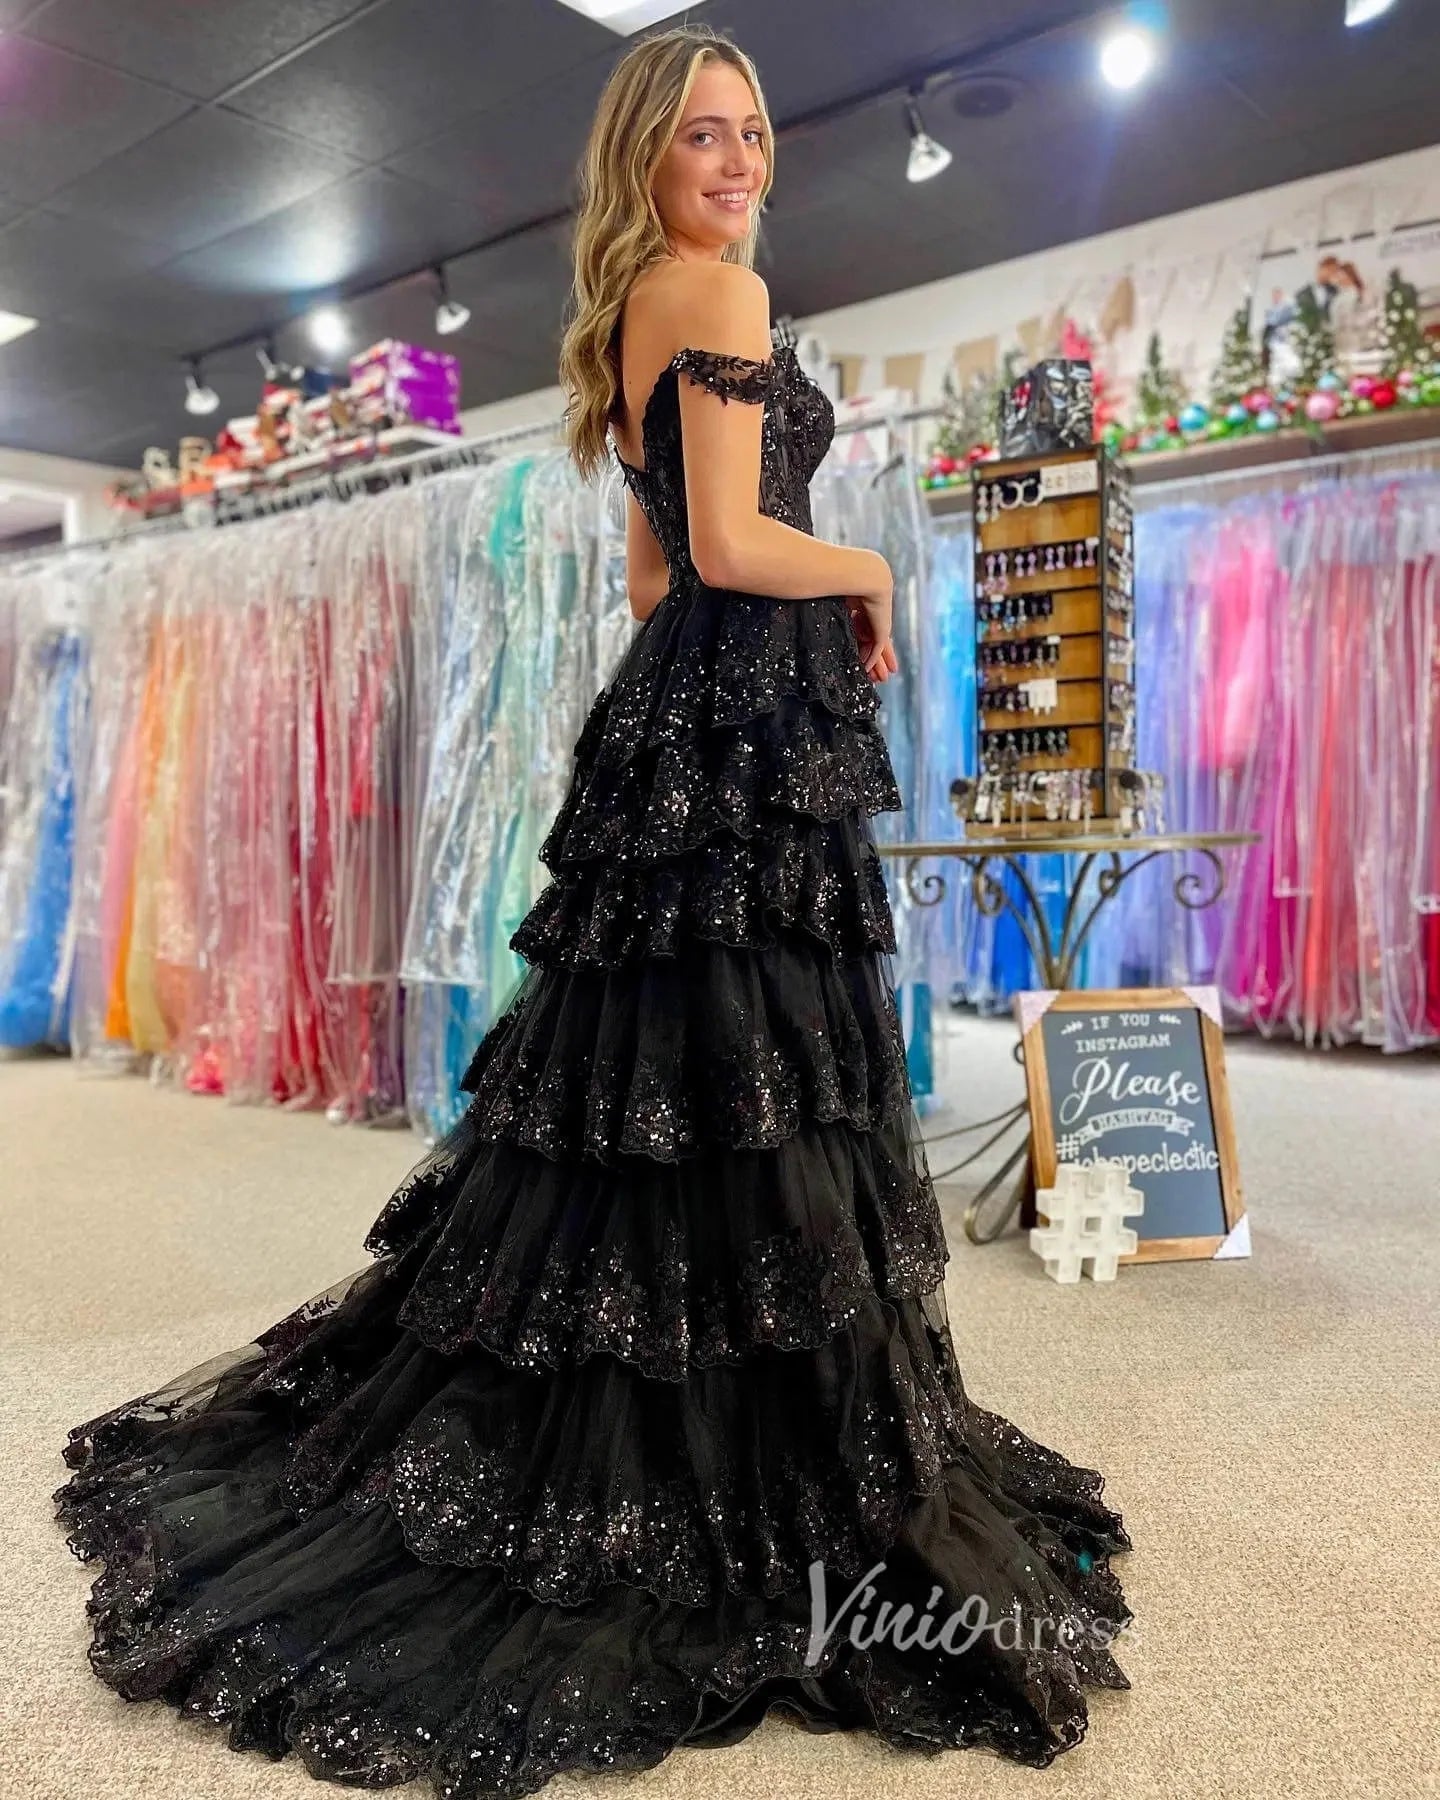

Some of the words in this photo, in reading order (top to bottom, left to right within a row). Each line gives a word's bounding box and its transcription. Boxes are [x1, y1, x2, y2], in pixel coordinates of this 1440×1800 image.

[1091, 1016, 1110, 1030] IF
[1119, 1013, 1150, 1027] YOU
[1076, 1034, 1171, 1053] INSTAGRAM
[1059, 1056, 1201, 1125] Please
[1100, 1111, 1168, 1130] HASHTAG
